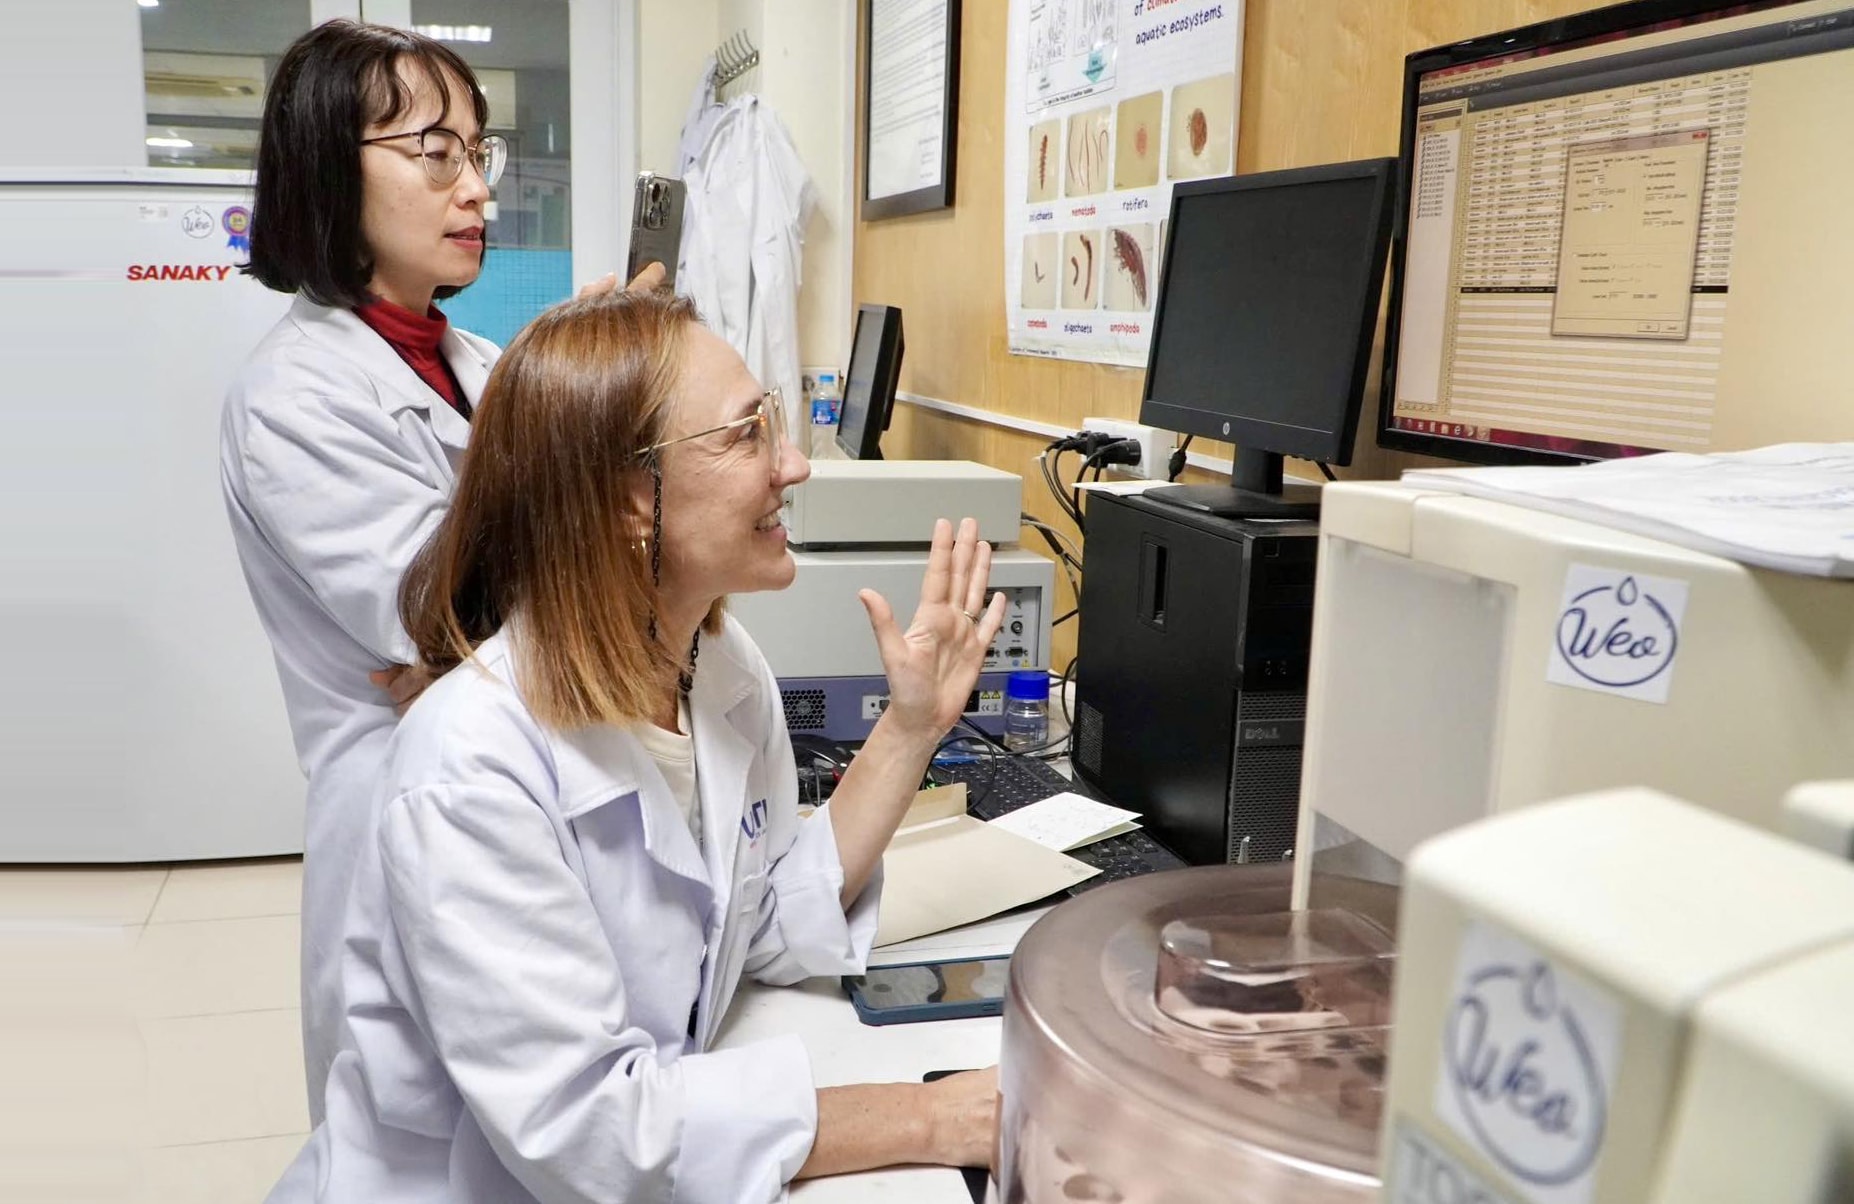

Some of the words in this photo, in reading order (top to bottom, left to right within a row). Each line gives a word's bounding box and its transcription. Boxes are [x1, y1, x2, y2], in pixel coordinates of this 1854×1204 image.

[1134, 0, 1144, 16] of
[1147, 0, 1178, 10] clim
[1135, 25, 1167, 46] aquatic
[1122, 197, 1148, 212] rotifera
[127, 265, 231, 281] SANAKY
[1110, 320, 1140, 336] amphipoda
